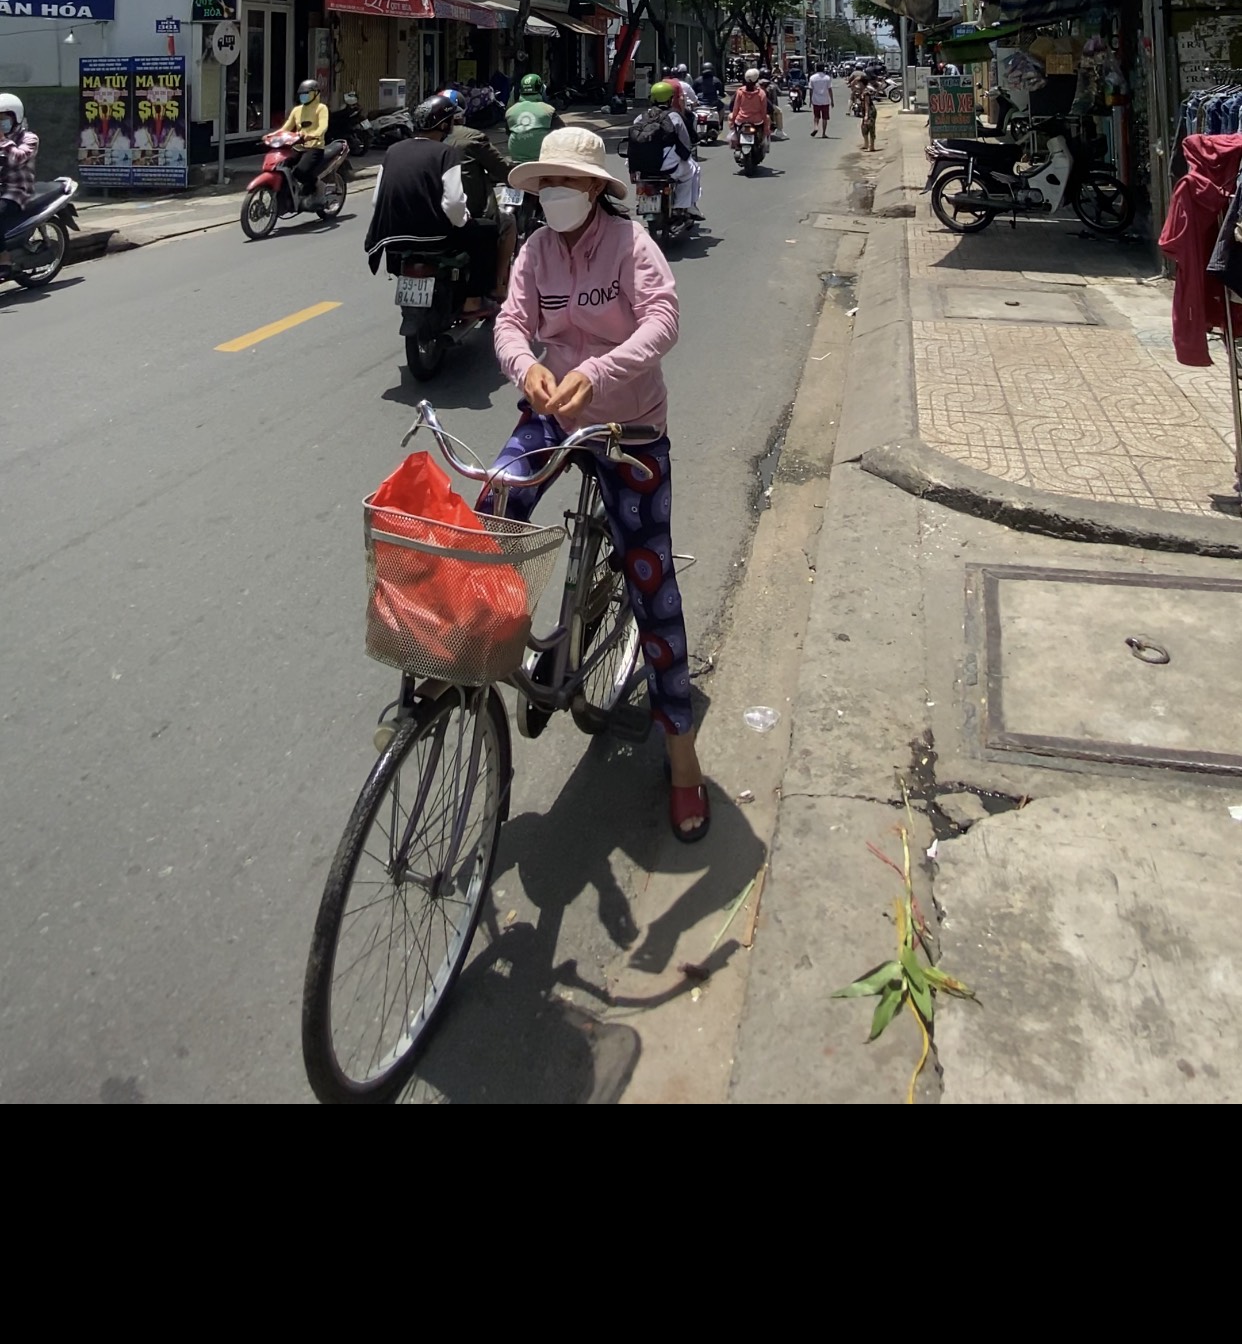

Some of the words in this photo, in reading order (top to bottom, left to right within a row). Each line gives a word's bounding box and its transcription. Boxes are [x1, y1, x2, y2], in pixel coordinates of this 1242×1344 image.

[41, 1, 93, 18] HÓA
[204, 8, 222, 17] HÒA
[83, 76, 101, 88] MA
[104, 72, 128, 88] TÚY
[136, 75, 154, 88] MA
[157, 72, 181, 87] TÚY
[138, 100, 180, 122] SOS
[958, 93, 974, 113] XE
[85, 101, 126, 123] SOS
